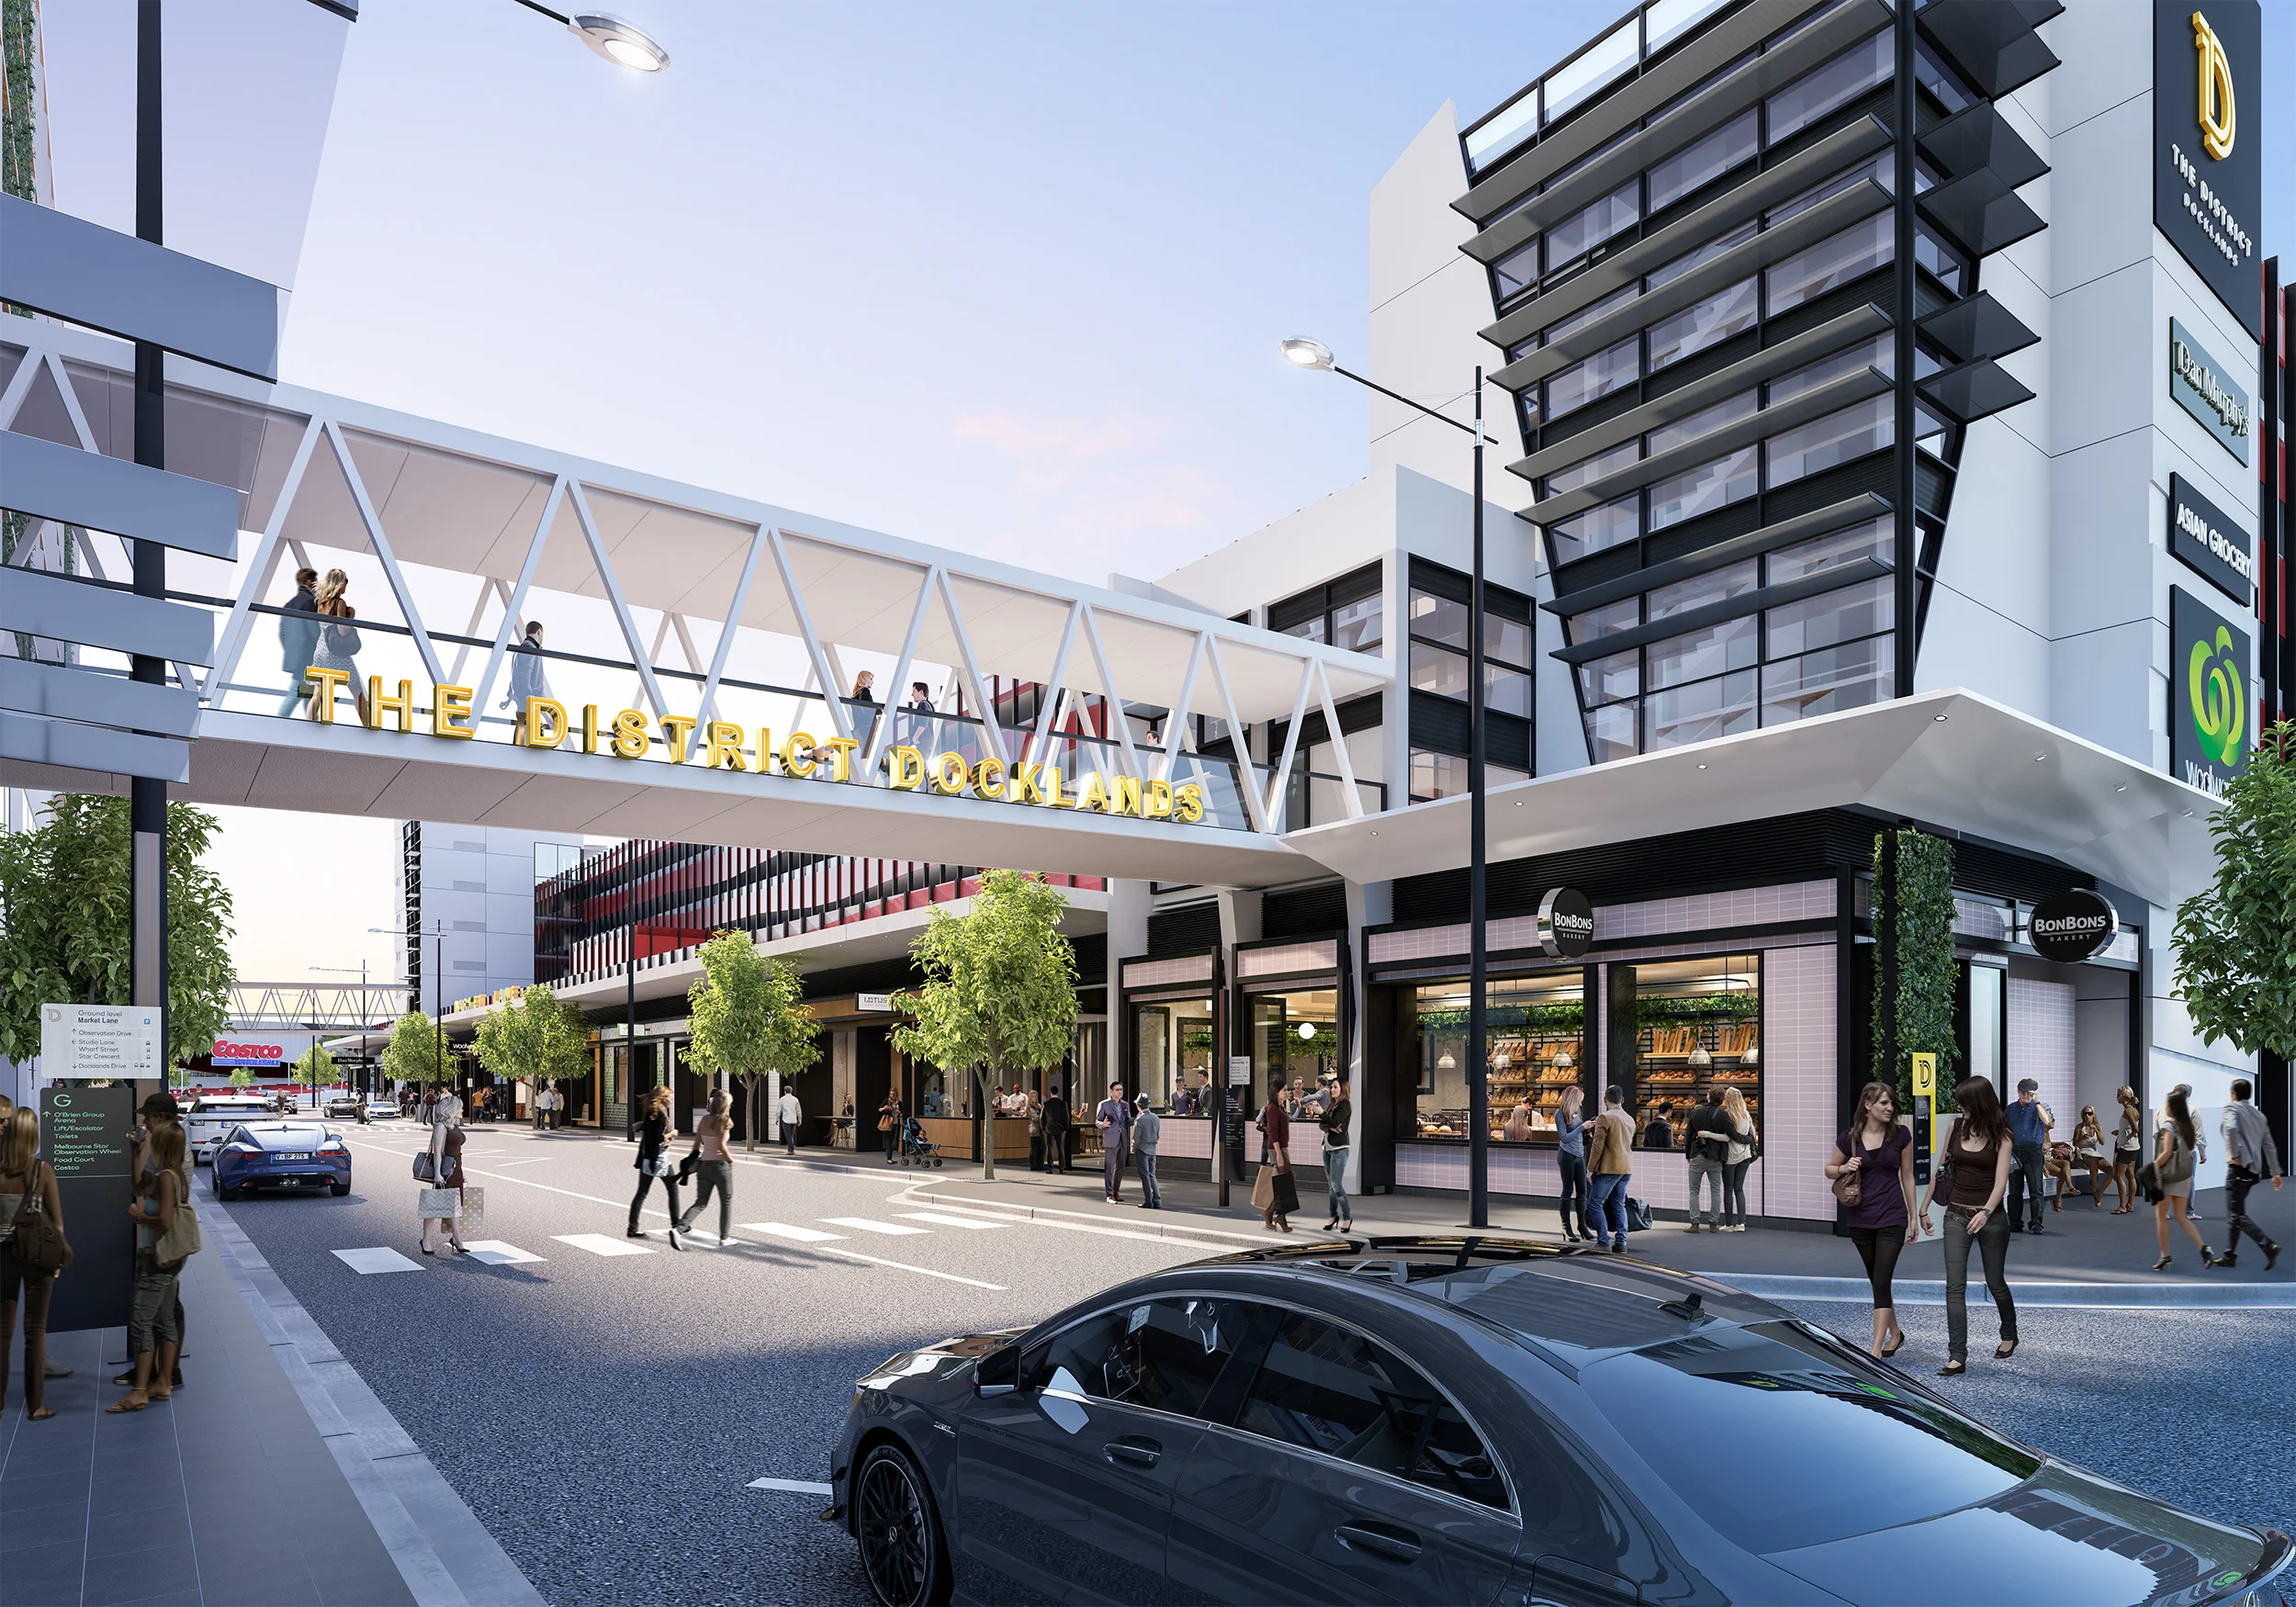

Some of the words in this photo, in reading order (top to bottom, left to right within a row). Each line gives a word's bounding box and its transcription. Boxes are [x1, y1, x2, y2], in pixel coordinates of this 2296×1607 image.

[2171, 143, 2196, 188] THE
[2199, 179, 2253, 258] DISTRICT
[2182, 192, 2239, 267] DOCKLANDS
[2176, 340, 2203, 390] Dan
[2204, 365, 2250, 436] Murphy's
[2177, 502, 2208, 546] ASIAN
[2208, 528, 2252, 579] GROCERY
[304, 666, 475, 741] THE
[525, 695, 859, 782] DISTRICT
[889, 745, 1204, 824] DOCKLANDS
[1562, 932, 1585, 940] BAKERY
[2049, 933, 2091, 942] BAKERY
[212, 1039, 283, 1059] COSTCO
[53, 1094, 72, 1107] G
